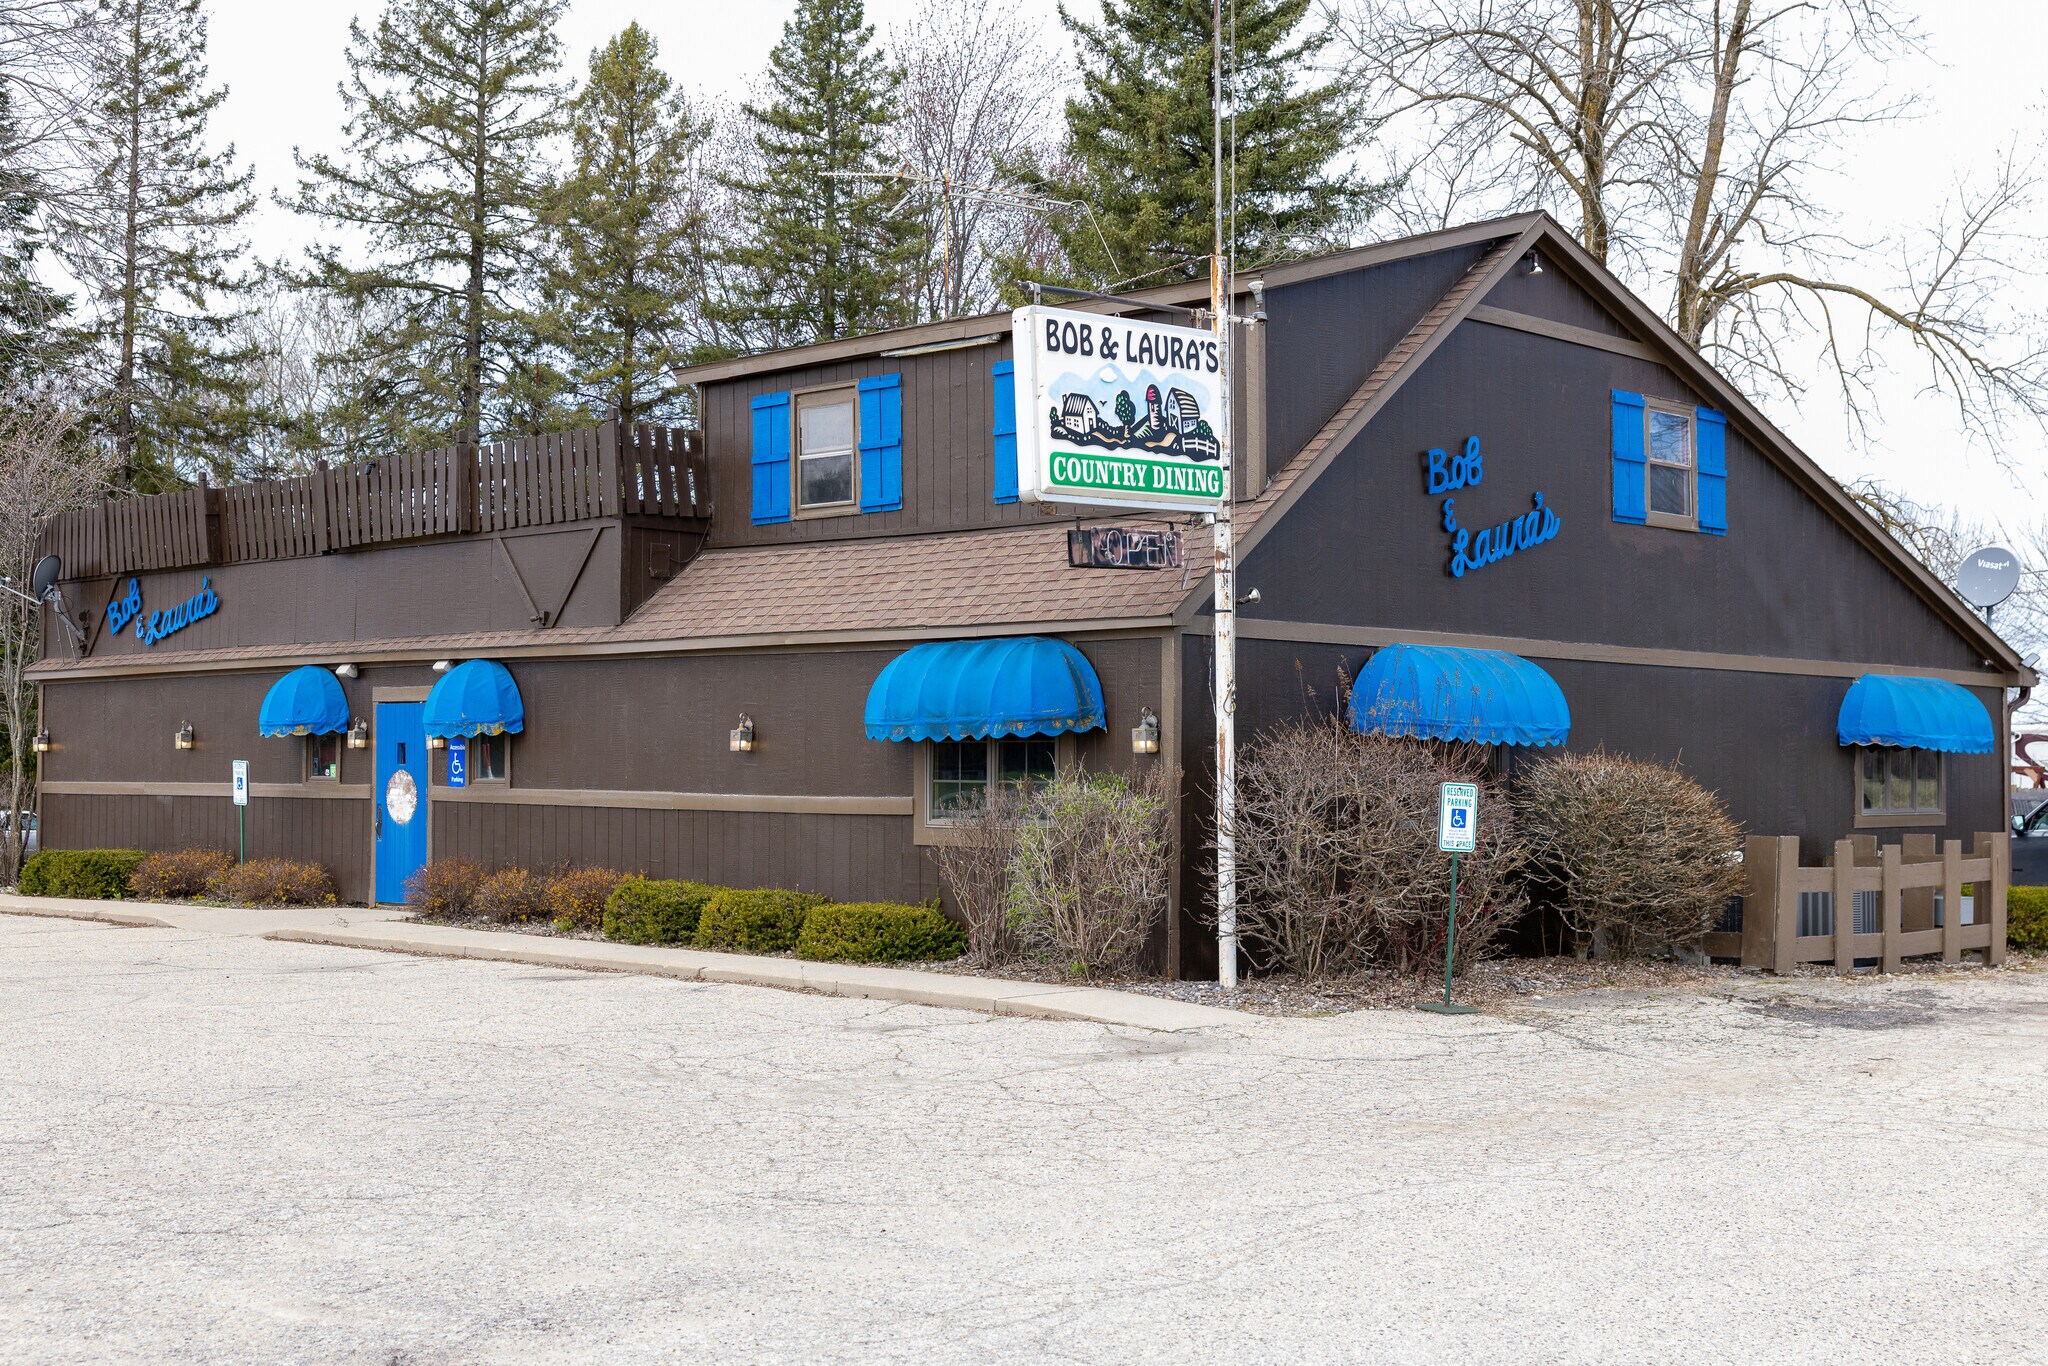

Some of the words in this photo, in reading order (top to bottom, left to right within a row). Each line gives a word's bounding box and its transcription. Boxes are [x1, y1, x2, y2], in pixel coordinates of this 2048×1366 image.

[1046, 318, 1094, 356] BOB
[1099, 326, 1120, 360] &
[1126, 330, 1219, 373] LAURA'S
[1053, 455, 1148, 488] COUNTRY
[1152, 464, 1220, 494] DINING
[1428, 435, 1483, 494] Bob
[1443, 498, 1457, 533] &
[1106, 530, 1178, 567] OPEN
[1451, 490, 1561, 578] Laura's
[1977, 558, 2003, 570] Viasat
[106, 577, 141, 636] Bob
[144, 576, 219, 646] Laura's
[451, 776, 464, 784] Parking
[1446, 787, 1474, 798] RESERVED
[1447, 797, 1473, 808] PARKING
[1443, 839, 1455, 848] THIS
[1456, 840, 1472, 849] SPACE
